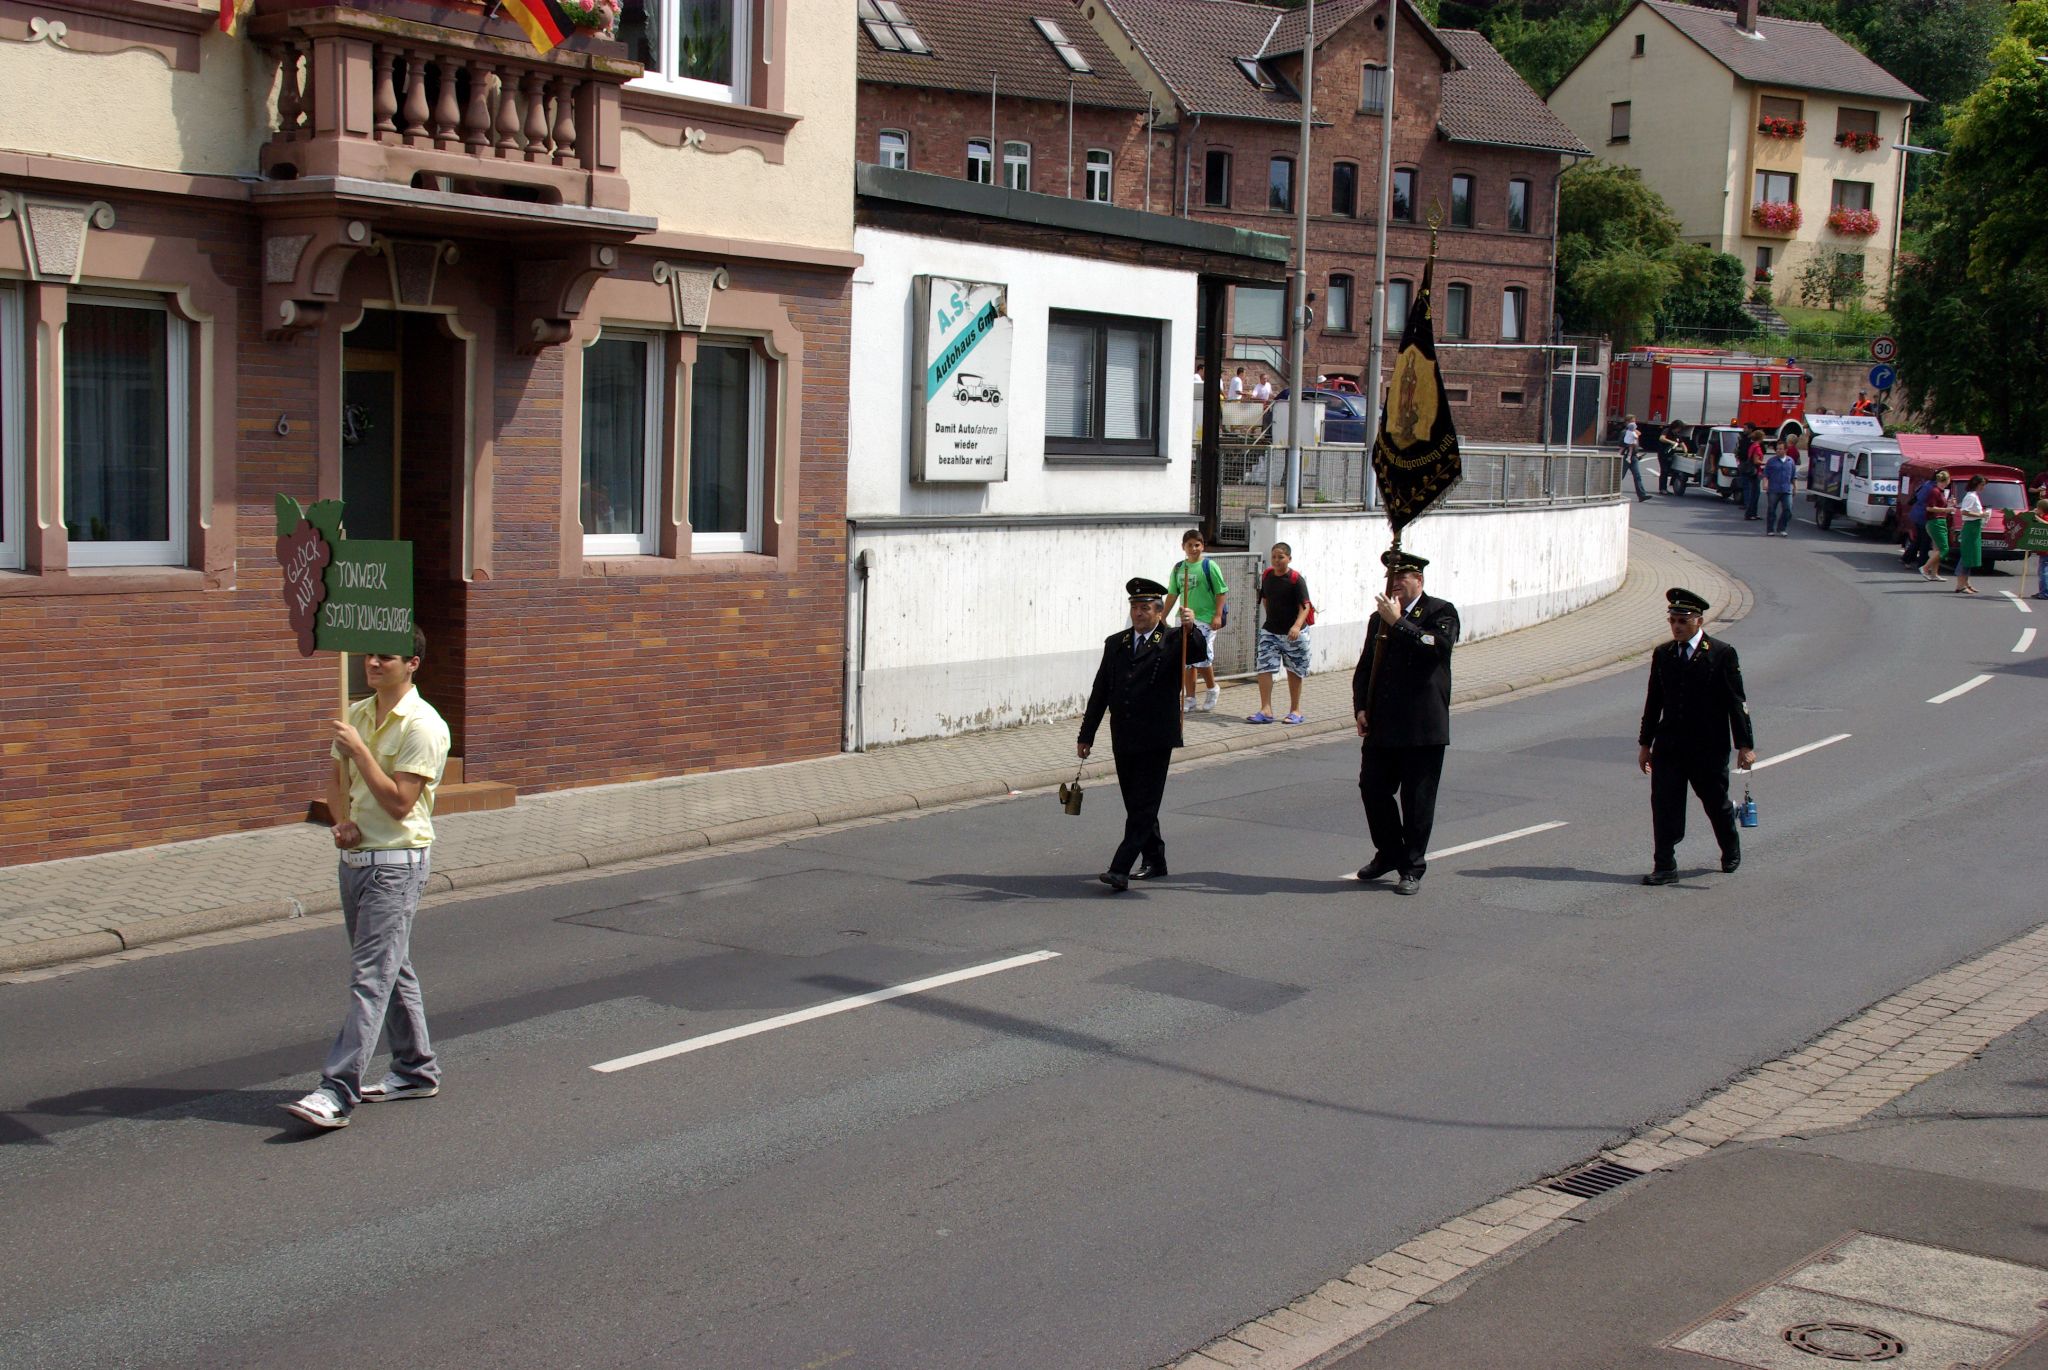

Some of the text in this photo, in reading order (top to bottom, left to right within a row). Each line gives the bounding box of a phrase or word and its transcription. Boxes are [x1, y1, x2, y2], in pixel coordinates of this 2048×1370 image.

[936, 330, 976, 384] Autohaus
[1876, 343, 1892, 355] 30
[278, 413, 289, 435] 6
[935, 422, 998, 435] Damit Autofahren
[954, 439, 978, 449] wieder
[938, 454, 993, 465] bezahlbar wird!
[287, 535, 321, 584] GLÜCK
[335, 560, 388, 590] TONWERK
[296, 566, 315, 616] AUF
[325, 602, 412, 633] STADT KLINGENBERG
